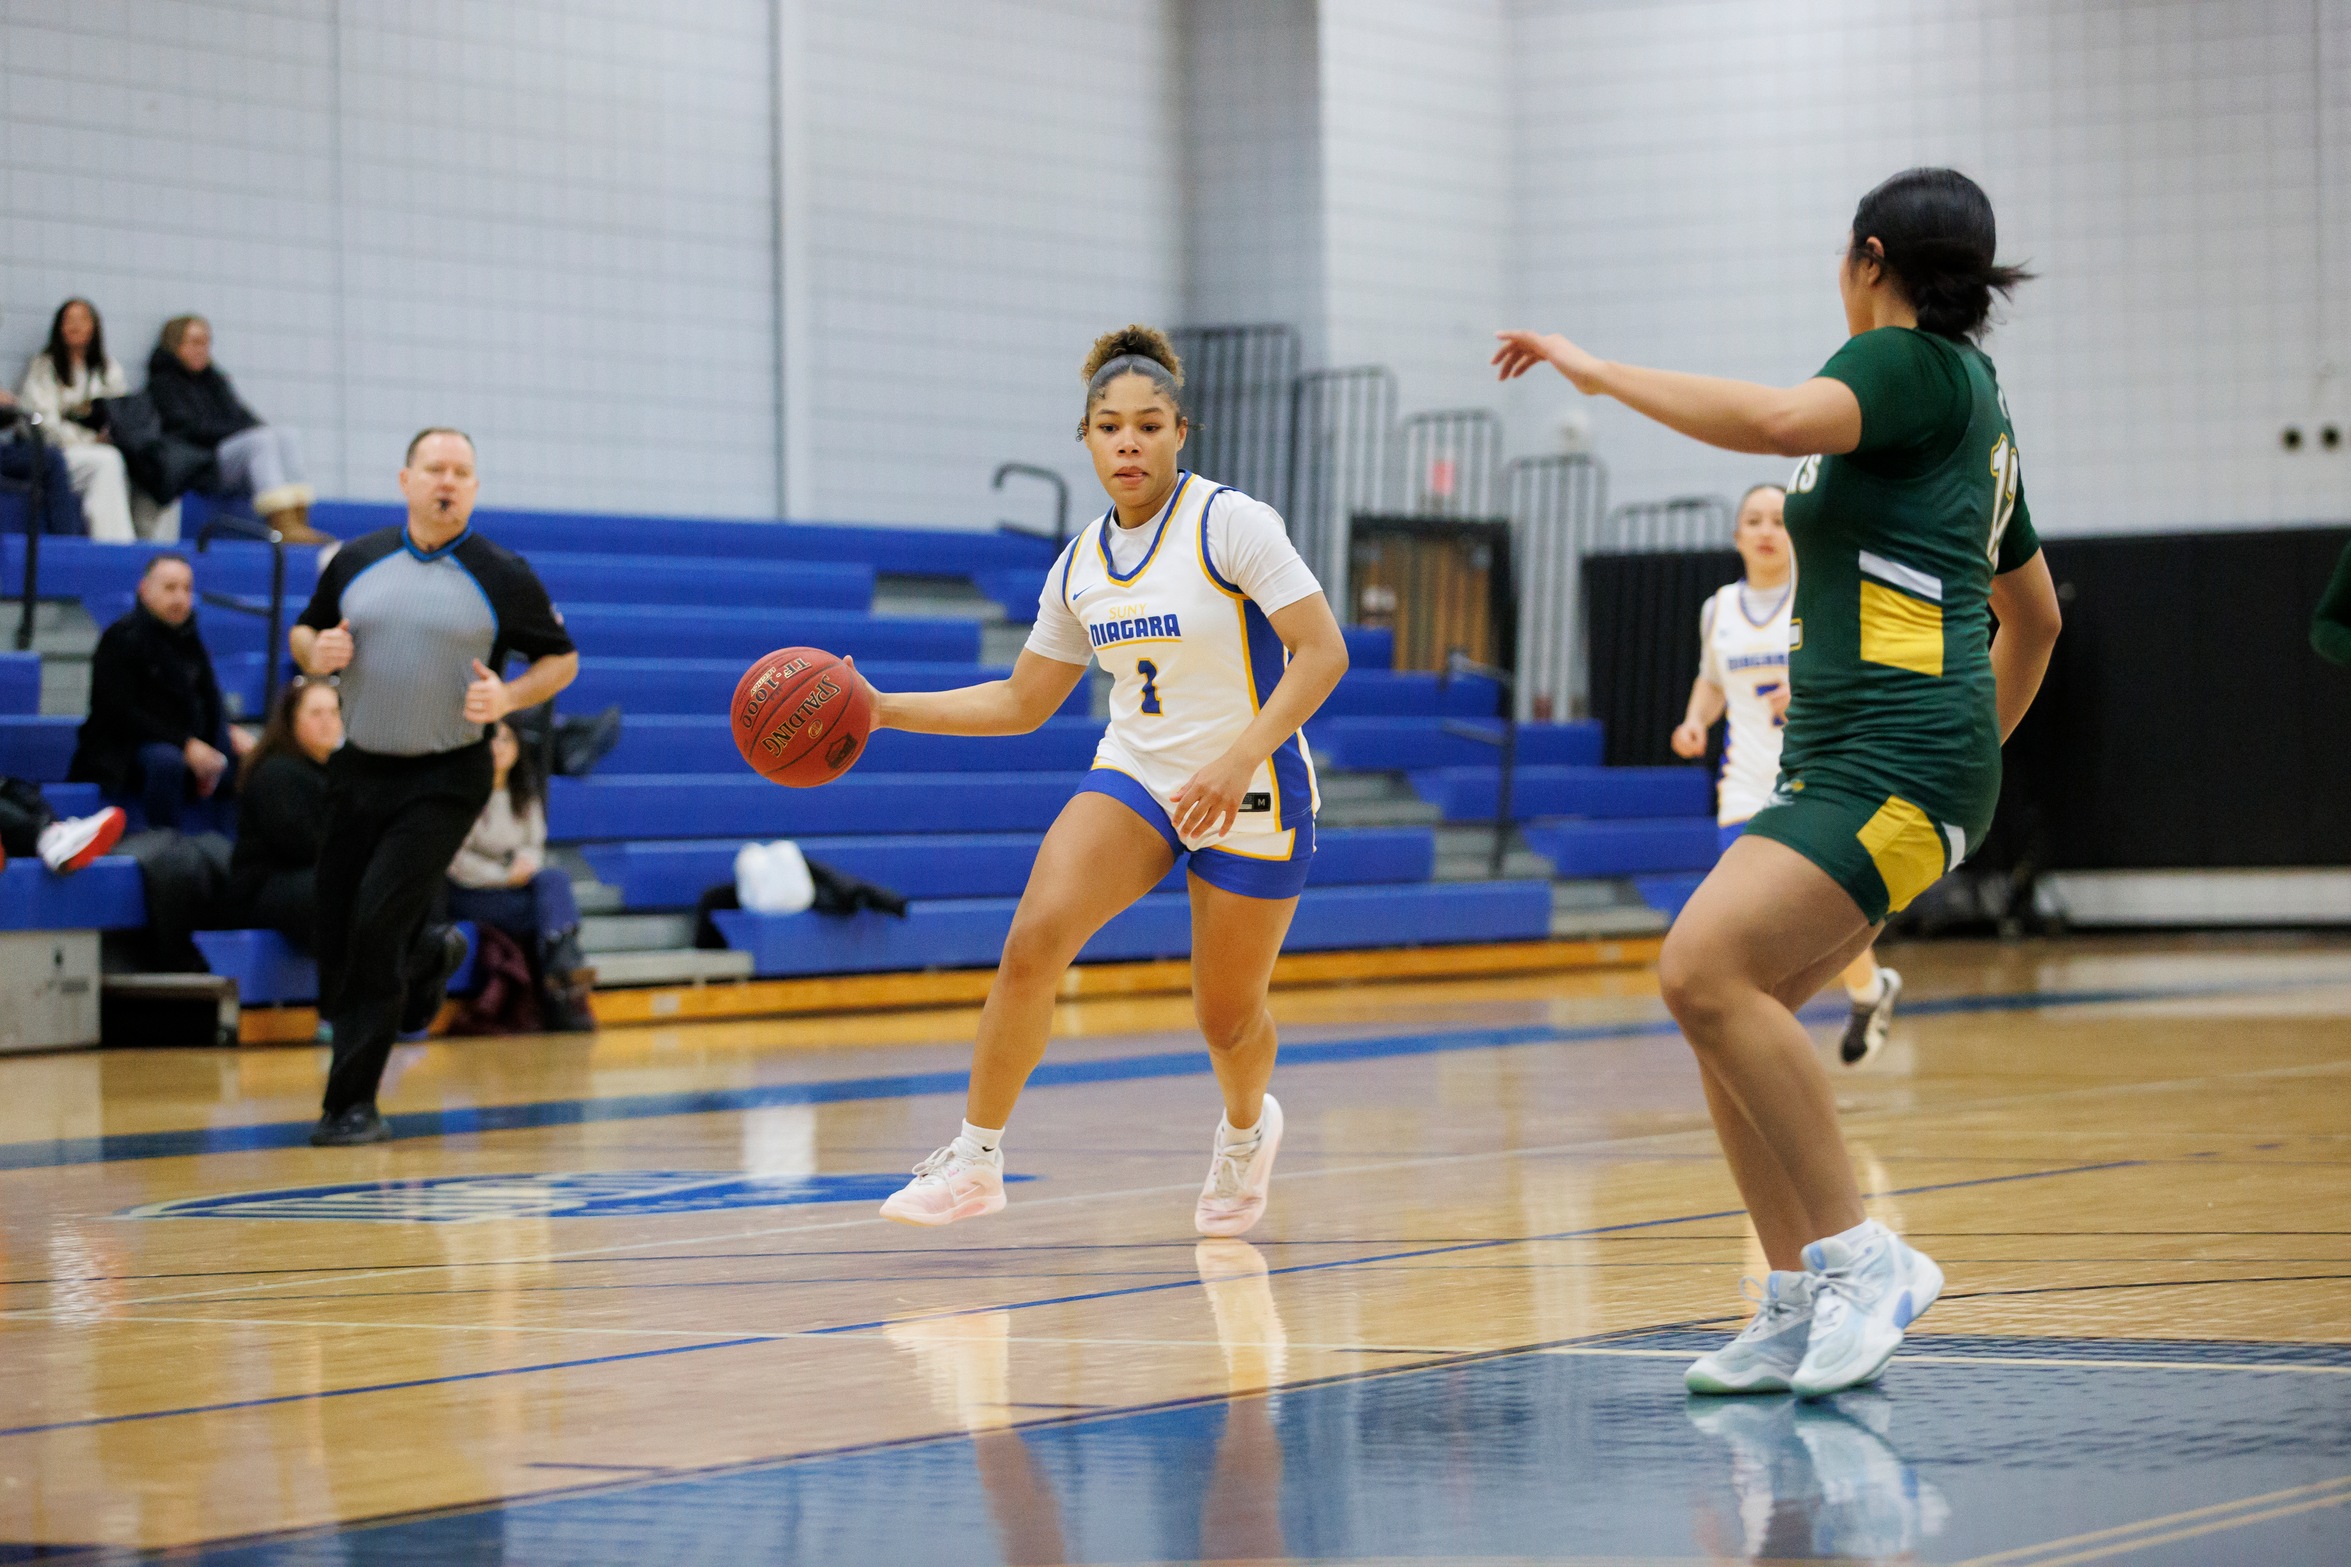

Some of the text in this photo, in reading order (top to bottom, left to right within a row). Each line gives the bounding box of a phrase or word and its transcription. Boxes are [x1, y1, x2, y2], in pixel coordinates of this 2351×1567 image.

[1089, 613, 1182, 647] NIAGARA
[1108, 603, 1148, 621] SUNY
[742, 657, 811, 729] TF-1000
[762, 674, 841, 757] SPALDING
